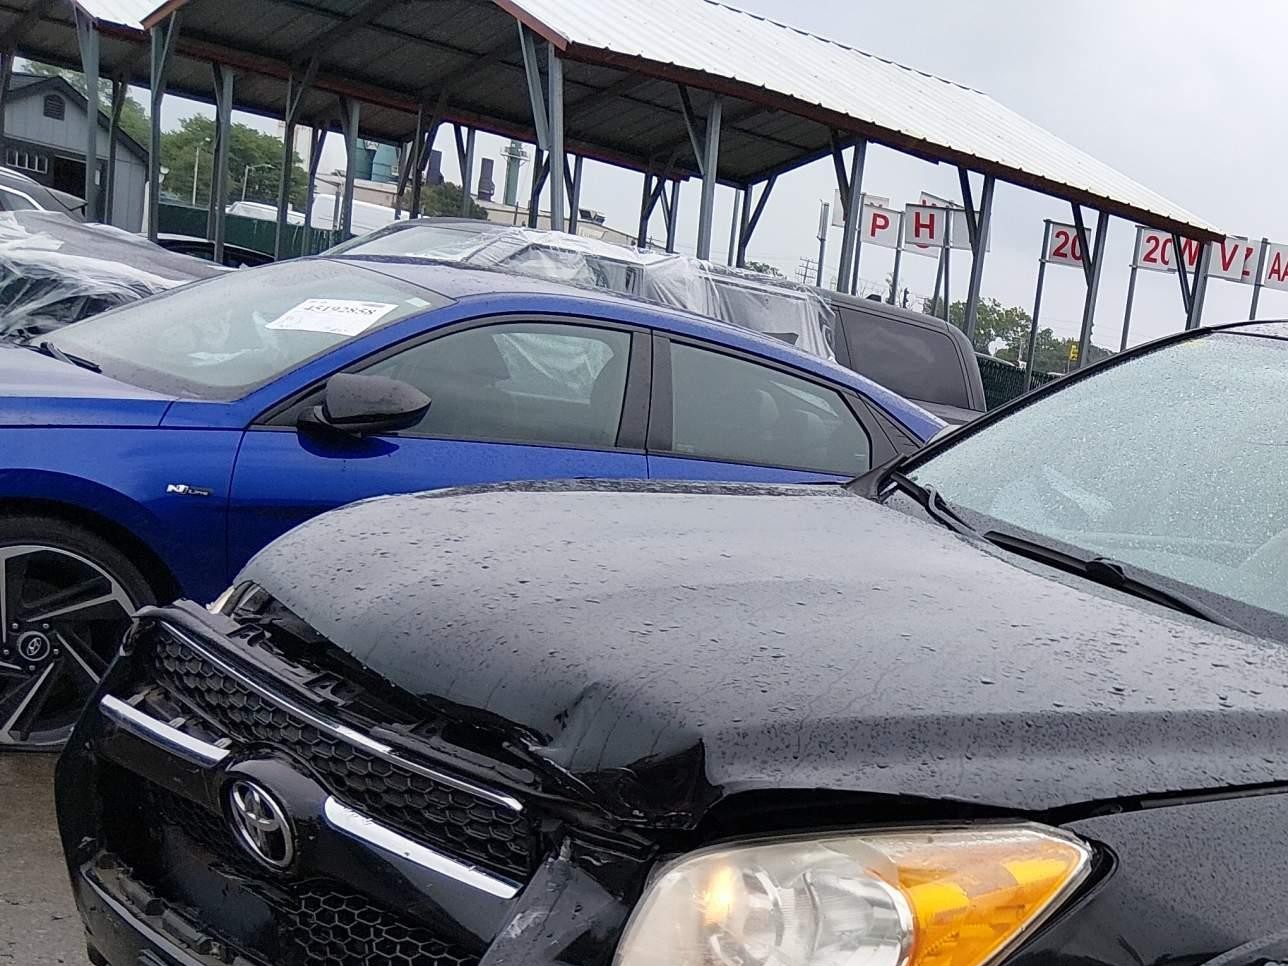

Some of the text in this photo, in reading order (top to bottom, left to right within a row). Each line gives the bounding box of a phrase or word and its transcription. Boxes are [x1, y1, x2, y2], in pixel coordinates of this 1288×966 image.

[870, 212, 890, 237] P
[914, 211, 935, 240] H
[1220, 241, 1239, 272] V
